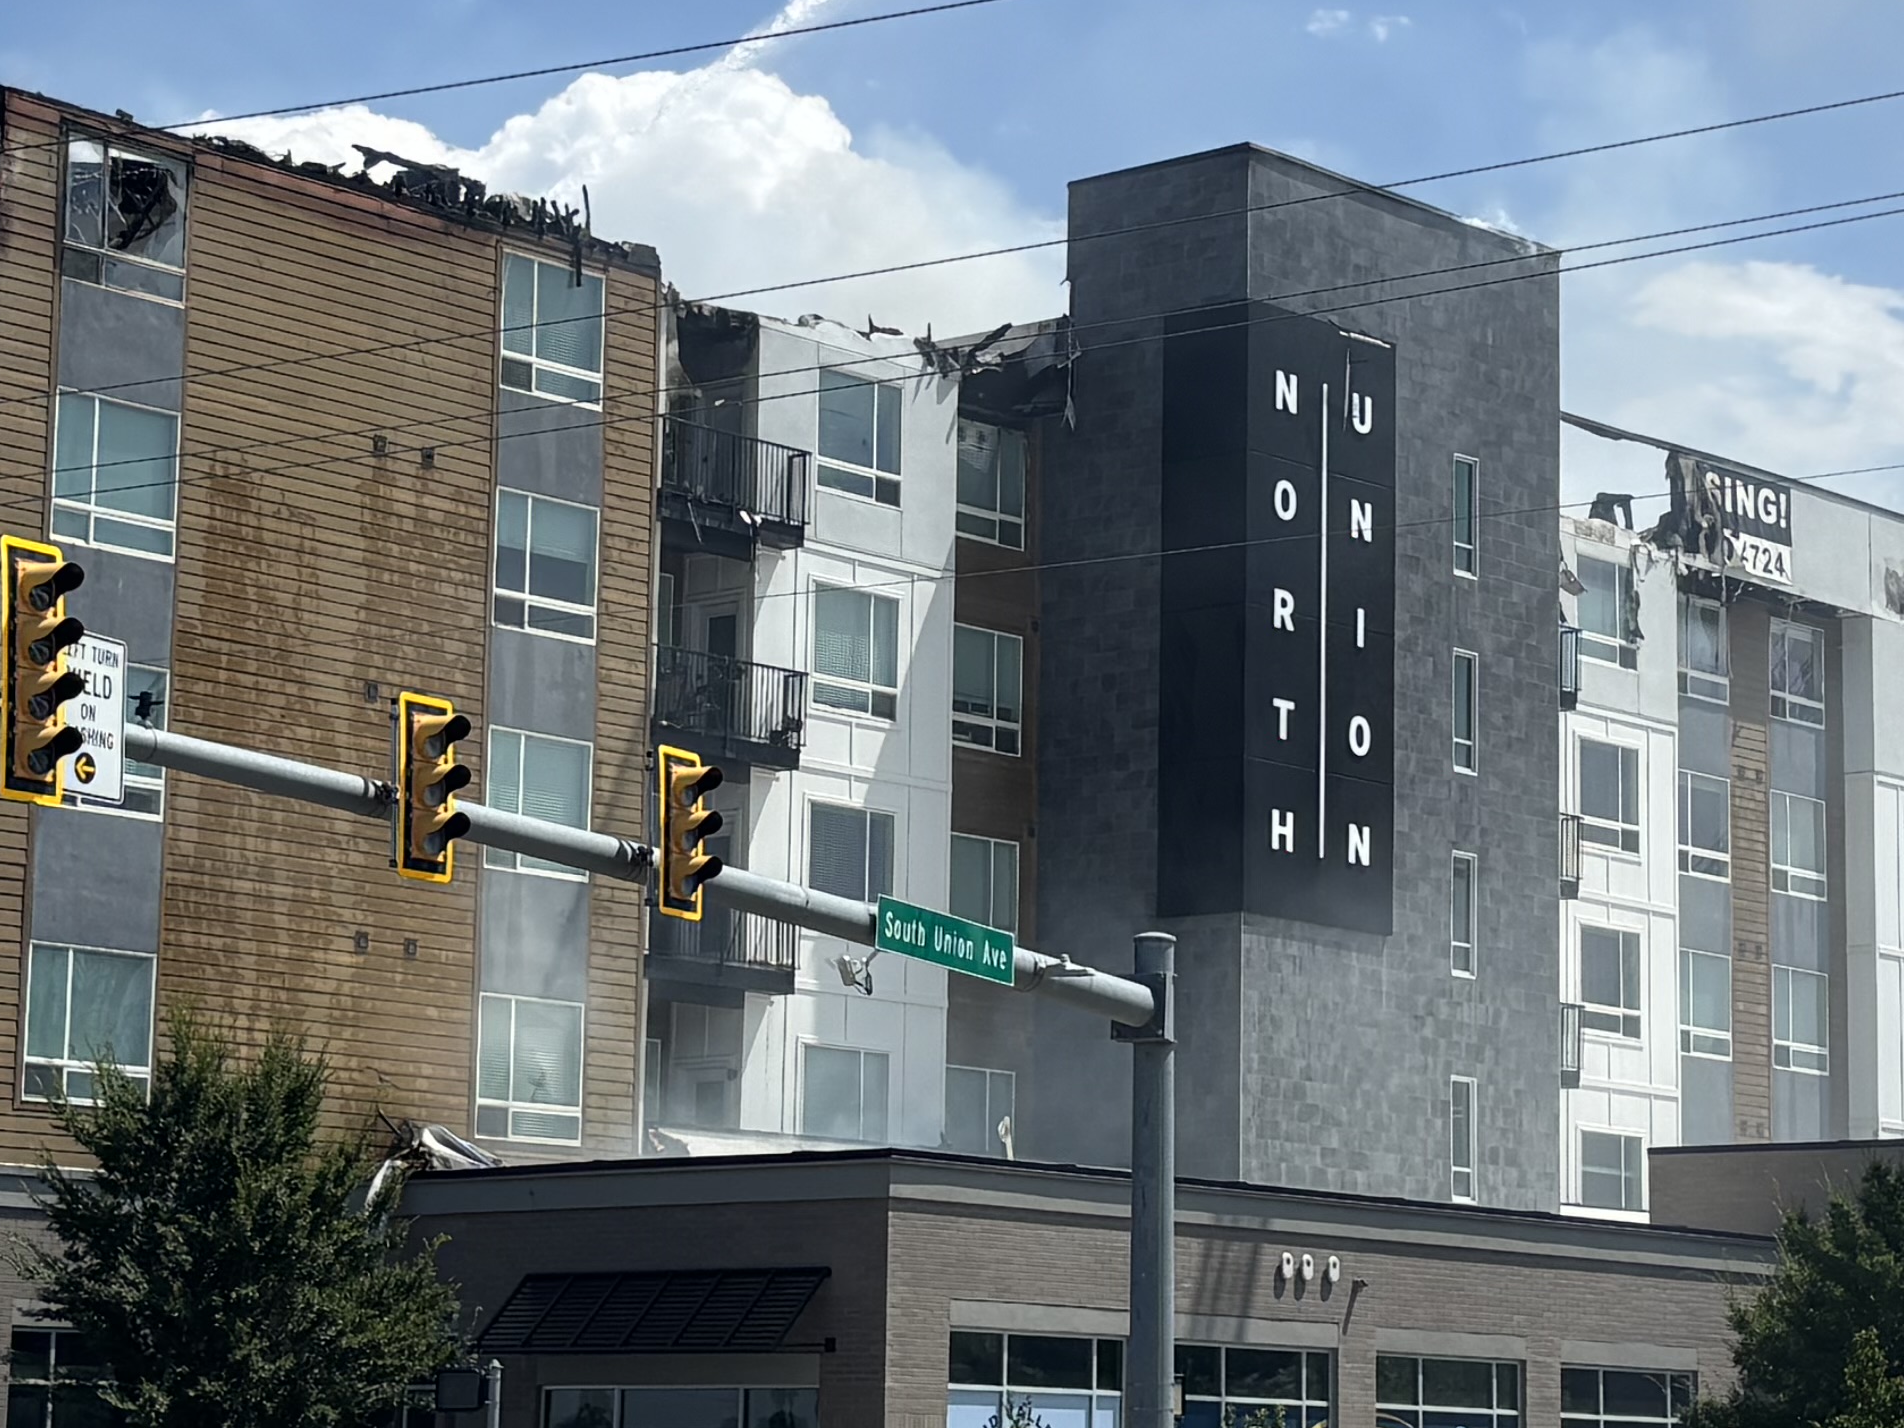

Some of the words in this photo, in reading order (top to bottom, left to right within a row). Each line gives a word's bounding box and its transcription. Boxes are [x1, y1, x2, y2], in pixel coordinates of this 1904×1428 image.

[1271, 370, 1298, 853] NORTH
[1348, 392, 1373, 867] UNION
[92, 646, 119, 668] TURN
[80, 703, 96, 721] ON
[884, 911, 926, 947] South
[934, 925, 974, 961] Union
[982, 939, 1008, 970] Ave
